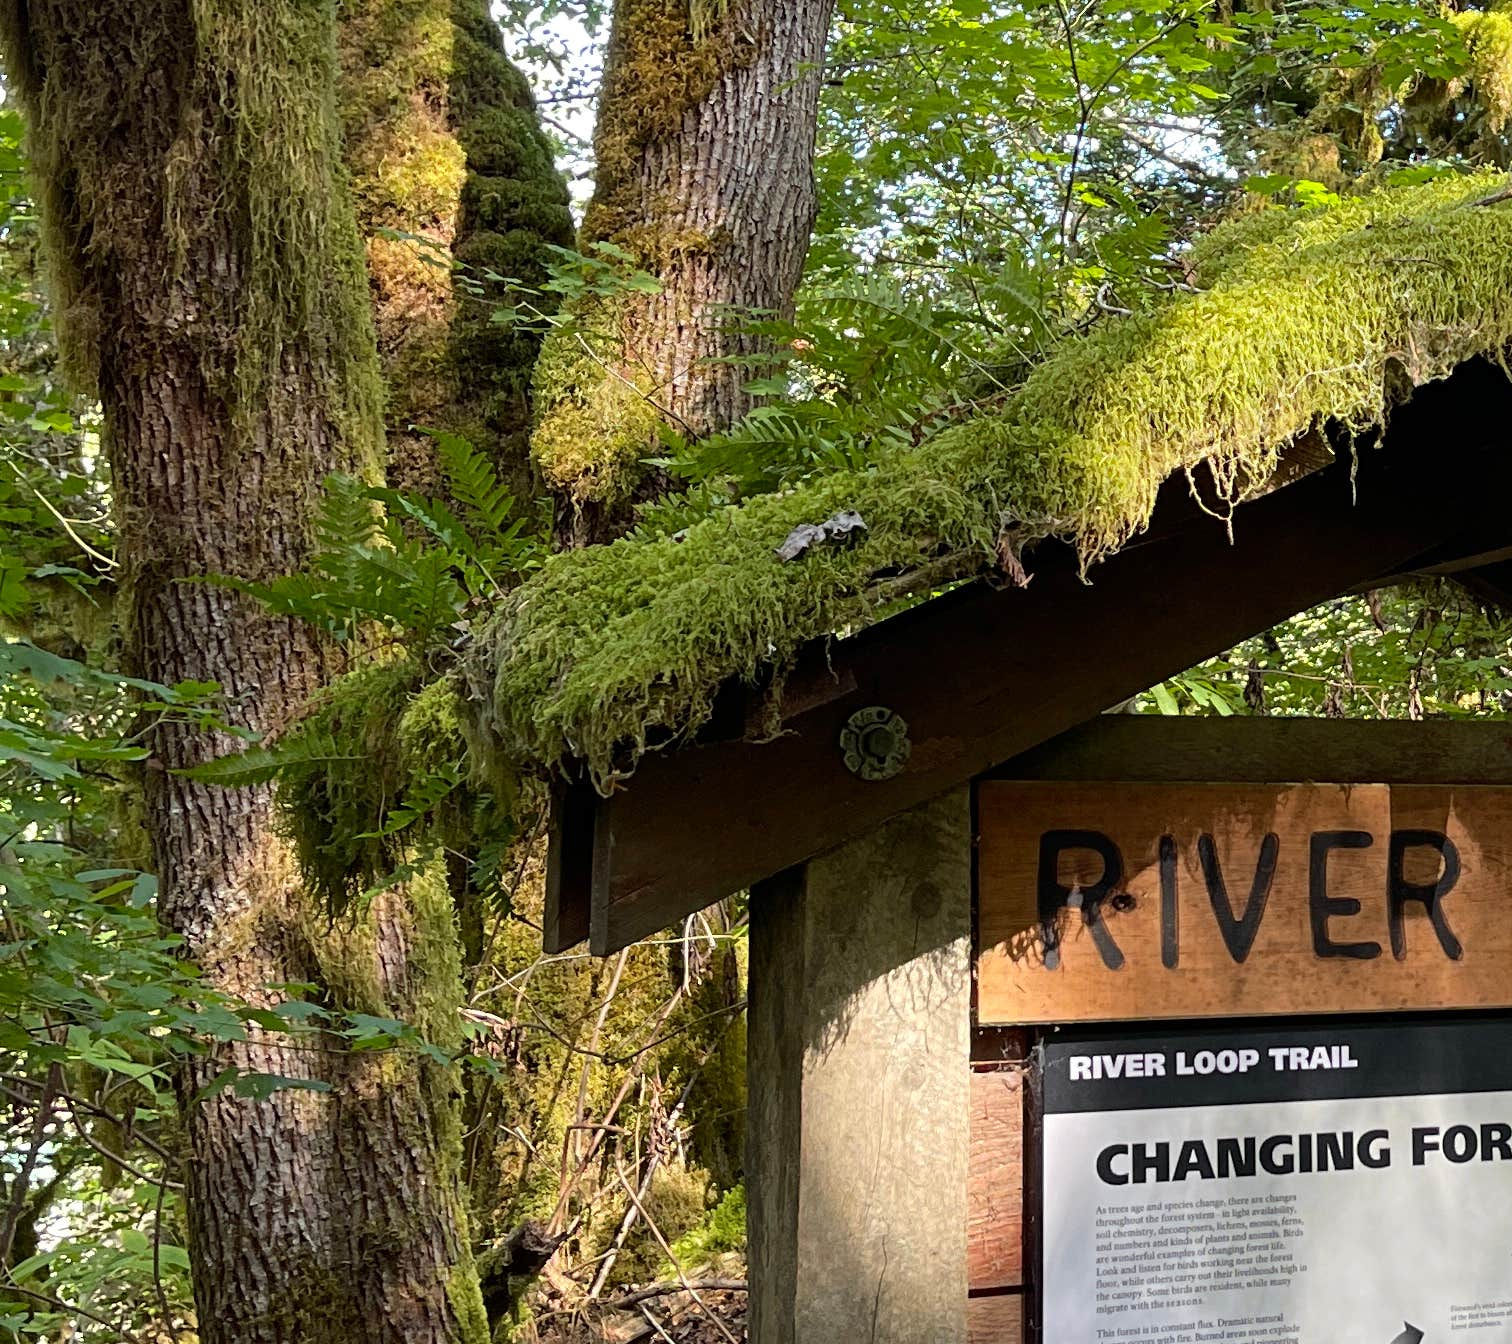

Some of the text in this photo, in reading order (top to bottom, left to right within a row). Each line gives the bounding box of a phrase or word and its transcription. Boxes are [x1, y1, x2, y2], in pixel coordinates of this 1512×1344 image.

[1036, 827, 1464, 971] RIVER
[1069, 1045, 1359, 1081] RIVER LOOP TRAIL
[1096, 1129, 1391, 1186] CHANGING
